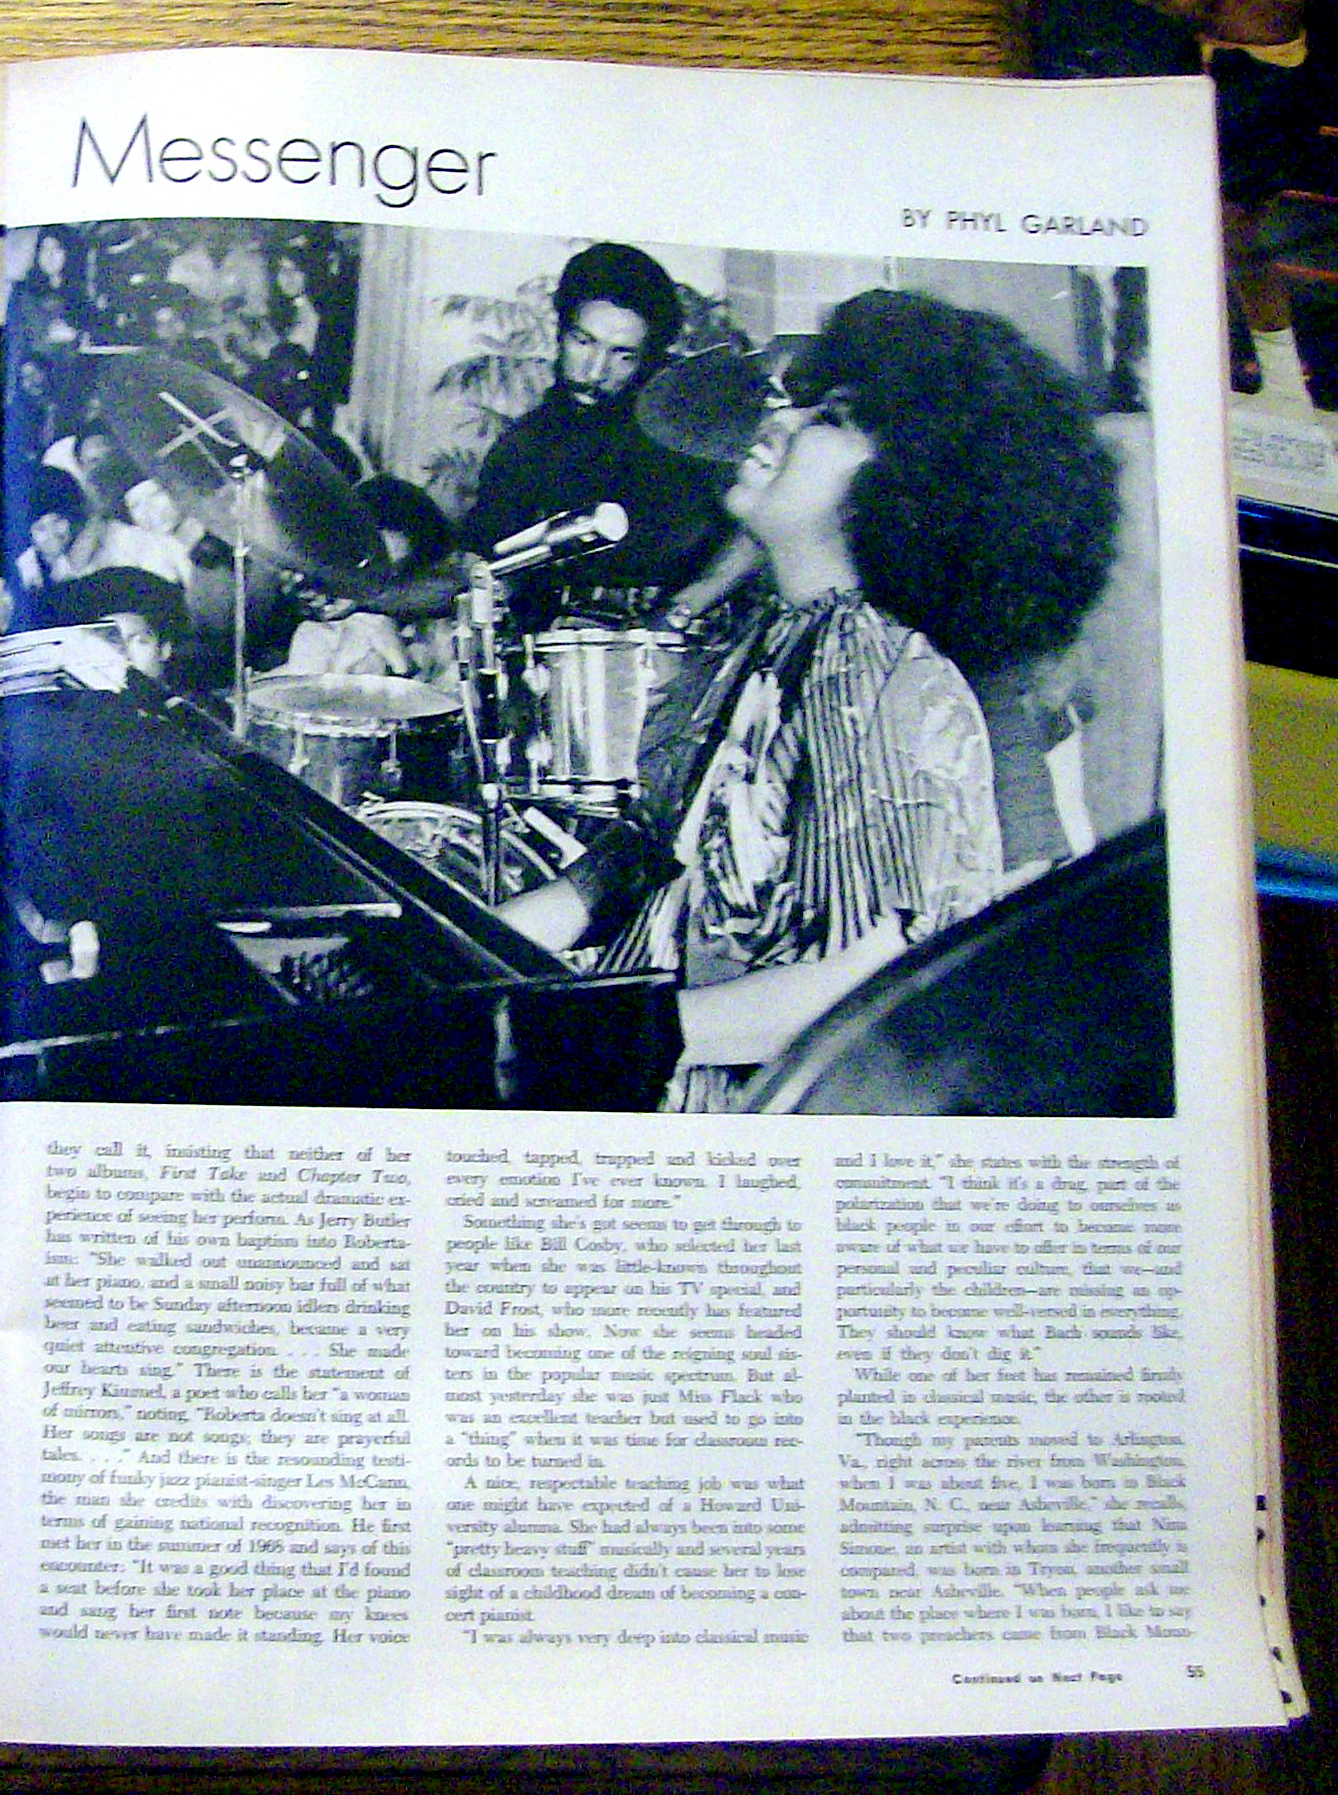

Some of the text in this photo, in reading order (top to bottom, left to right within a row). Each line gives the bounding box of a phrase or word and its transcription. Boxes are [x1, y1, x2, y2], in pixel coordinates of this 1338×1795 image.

[72, 112, 499, 208] Messenger
[901, 207, 1150, 238] BY PHYL GARLAND
[952, 1671, 1022, 1685] Continued
[1186, 1664, 1206, 1679] 55
